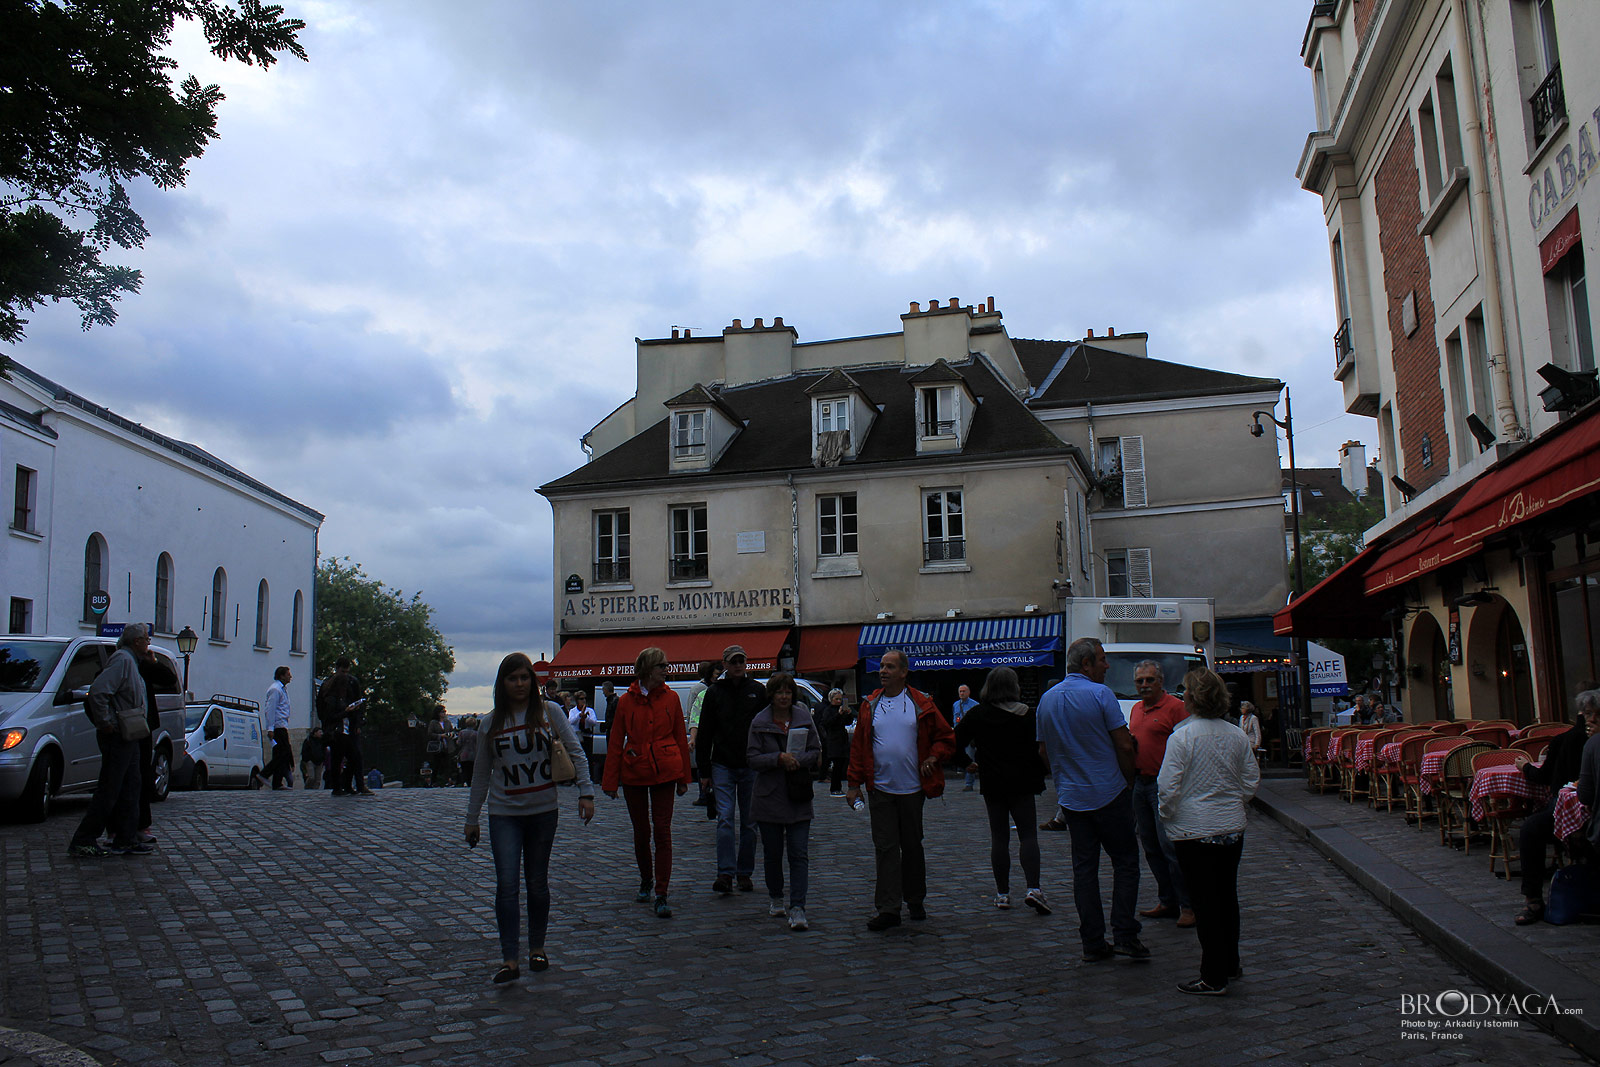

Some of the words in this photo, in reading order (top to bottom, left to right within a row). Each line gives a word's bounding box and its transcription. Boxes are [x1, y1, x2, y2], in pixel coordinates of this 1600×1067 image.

[92, 595, 107, 604] BUS
[564, 599, 576, 616] A
[600, 594, 659, 614] PIERRE
[663, 601, 675, 611] DE
[678, 587, 792, 611] MONTMARTRE
[651, 613, 698, 621] AQUARELLES
[902, 644, 945, 654] CLAIRON
[951, 643, 970, 652] DES
[975, 640, 1032, 651] CHASSEURS
[914, 658, 954, 667] AMBIANCE
[991, 655, 1034, 664] COCKTAILS
[553, 669, 592, 677] TABLEAUX
[600, 666, 606, 675] A
[616, 665, 635, 675] PIER
[745, 662, 771, 670] ENIRS
[1310, 671, 1342, 680] STAURANT
[494, 731, 552, 758] FUN
